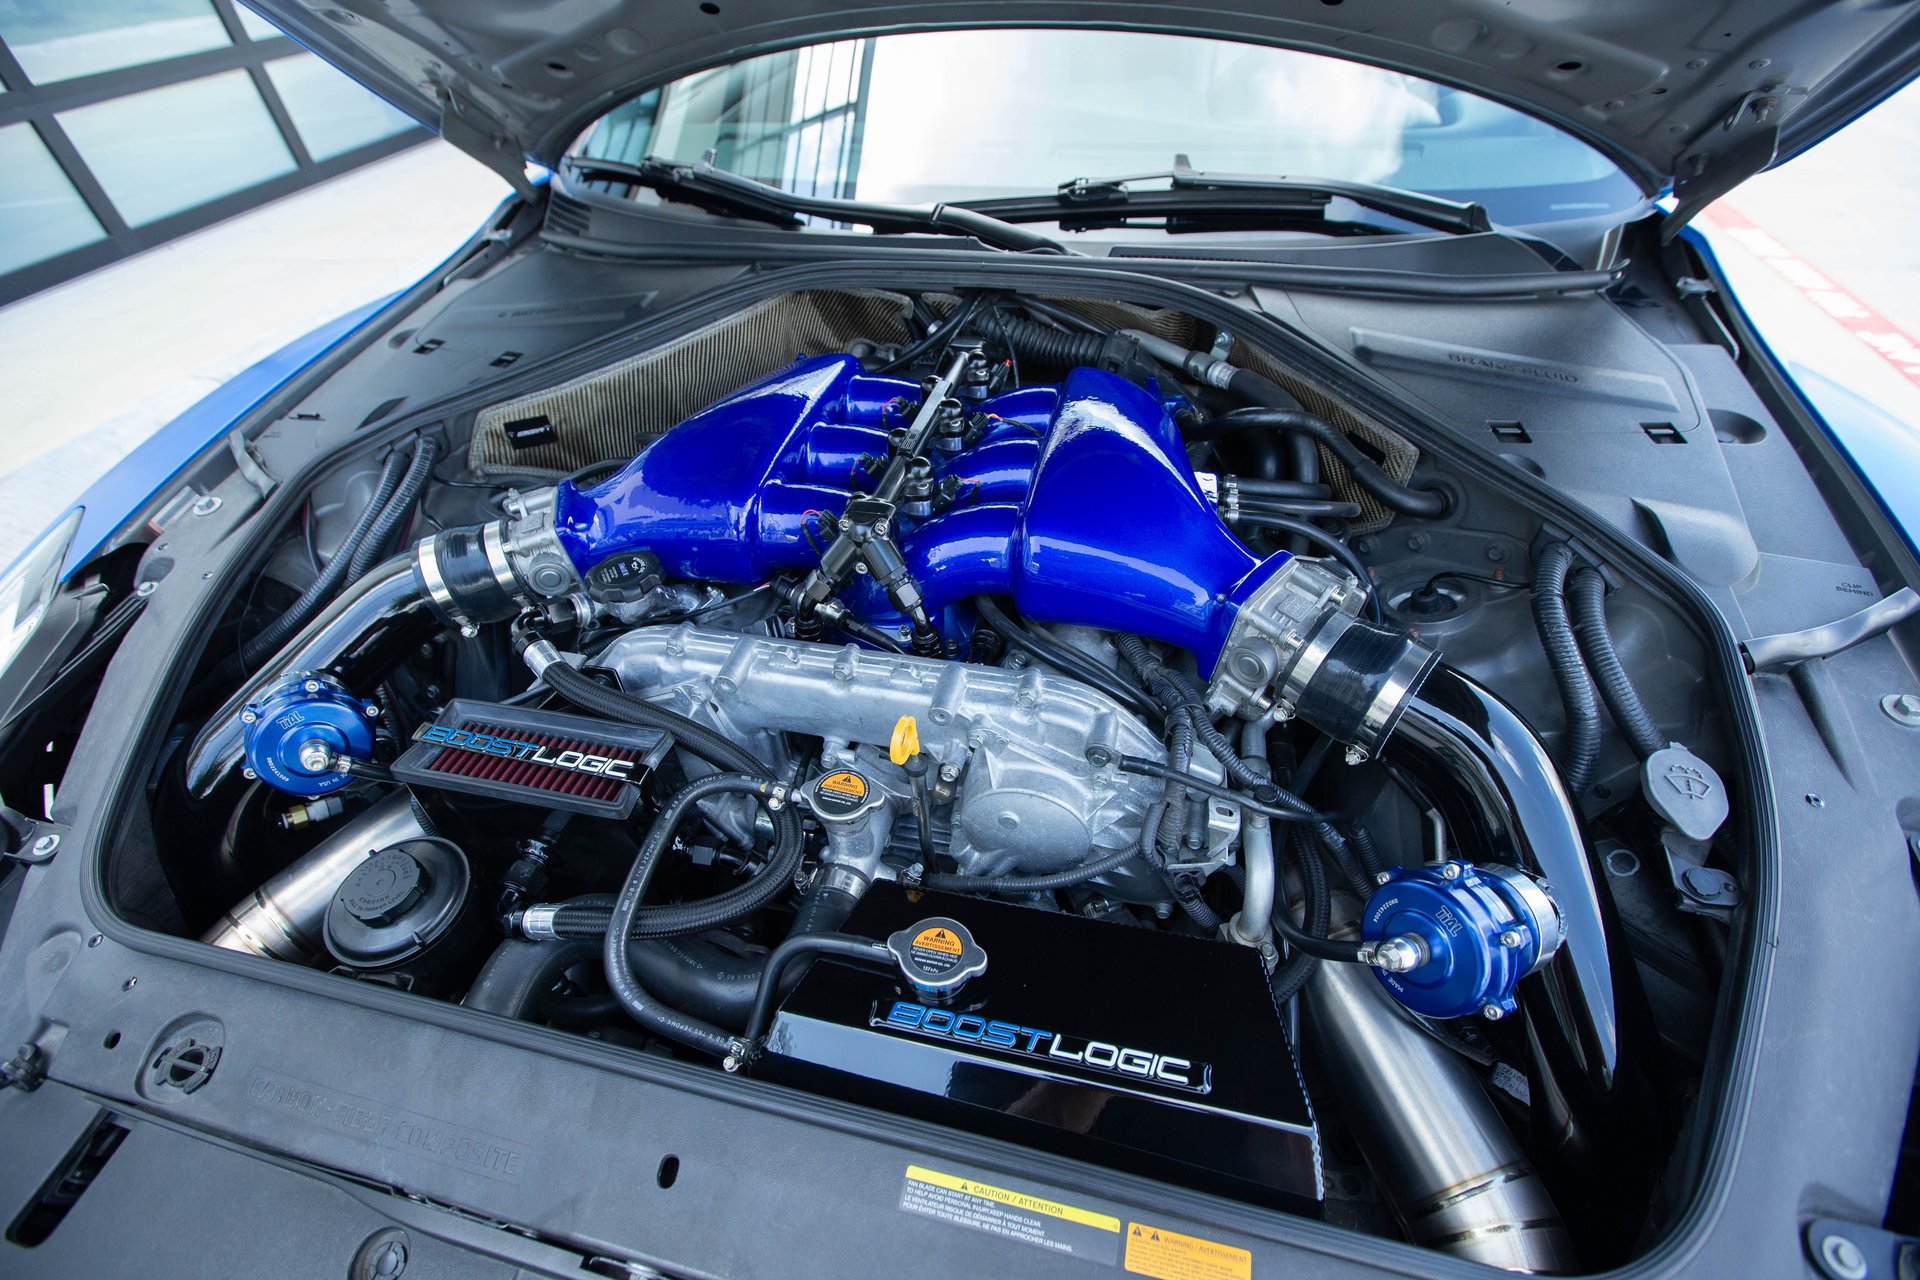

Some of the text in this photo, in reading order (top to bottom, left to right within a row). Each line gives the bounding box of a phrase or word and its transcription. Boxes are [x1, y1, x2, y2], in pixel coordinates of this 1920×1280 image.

[1449, 353, 1579, 383] BRAKE FLUID
[1835, 586, 1874, 597] BEHIND
[1841, 581, 1862, 589] CLIP
[823, 783, 862, 795] AVERTISSEMENT
[832, 780, 858, 789] WARNING
[915, 940, 960, 954] AVERTISSEMENT
[923, 935, 955, 947] WARNING
[1388, 976, 1404, 993] MADE
[250, 1076, 521, 1176] CARBON-FIBER COMPOSITE
[908, 1180, 919, 1188] FAN
[919, 1181, 935, 1192] BLADE
[936, 1186, 948, 1195] CAN
[948, 1189, 964, 1200] START
[964, 1193, 971, 1201] AT
[971, 1195, 983, 1205] ANY
[973, 1185, 1010, 1201] CAUTION
[1018, 1198, 1064, 1216] ATTENTION
[911, 1196, 944, 1210] VENTILATEUR
[945, 1204, 964, 1215] RISQUE
[964, 1209, 972, 1217] DE
[972, 1210, 1002, 1226] DÉMARRER
[1007, 1221, 1021, 1231] TOUT
[914, 1188, 928, 1197] HELP
[928, 1191, 945, 1202] AVOID
[945, 1196, 971, 1209] PERSONAL
[1004, 1212, 1022, 1223] HANDS
[903, 1201, 918, 1211] POUR
[937, 1210, 953, 1221] TOUTE
[982, 1222, 991, 1231] NE
[991, 1224, 1002, 1234] PAS
[1001, 1227, 1010, 1236] EN
[1009, 1230, 1044, 1245] APPROCHER
[1043, 1239, 1054, 1248] LES
[1164, 1237, 1194, 1250] WARNING
[1198, 1246, 1247, 1264] AVERTISSEMENT
